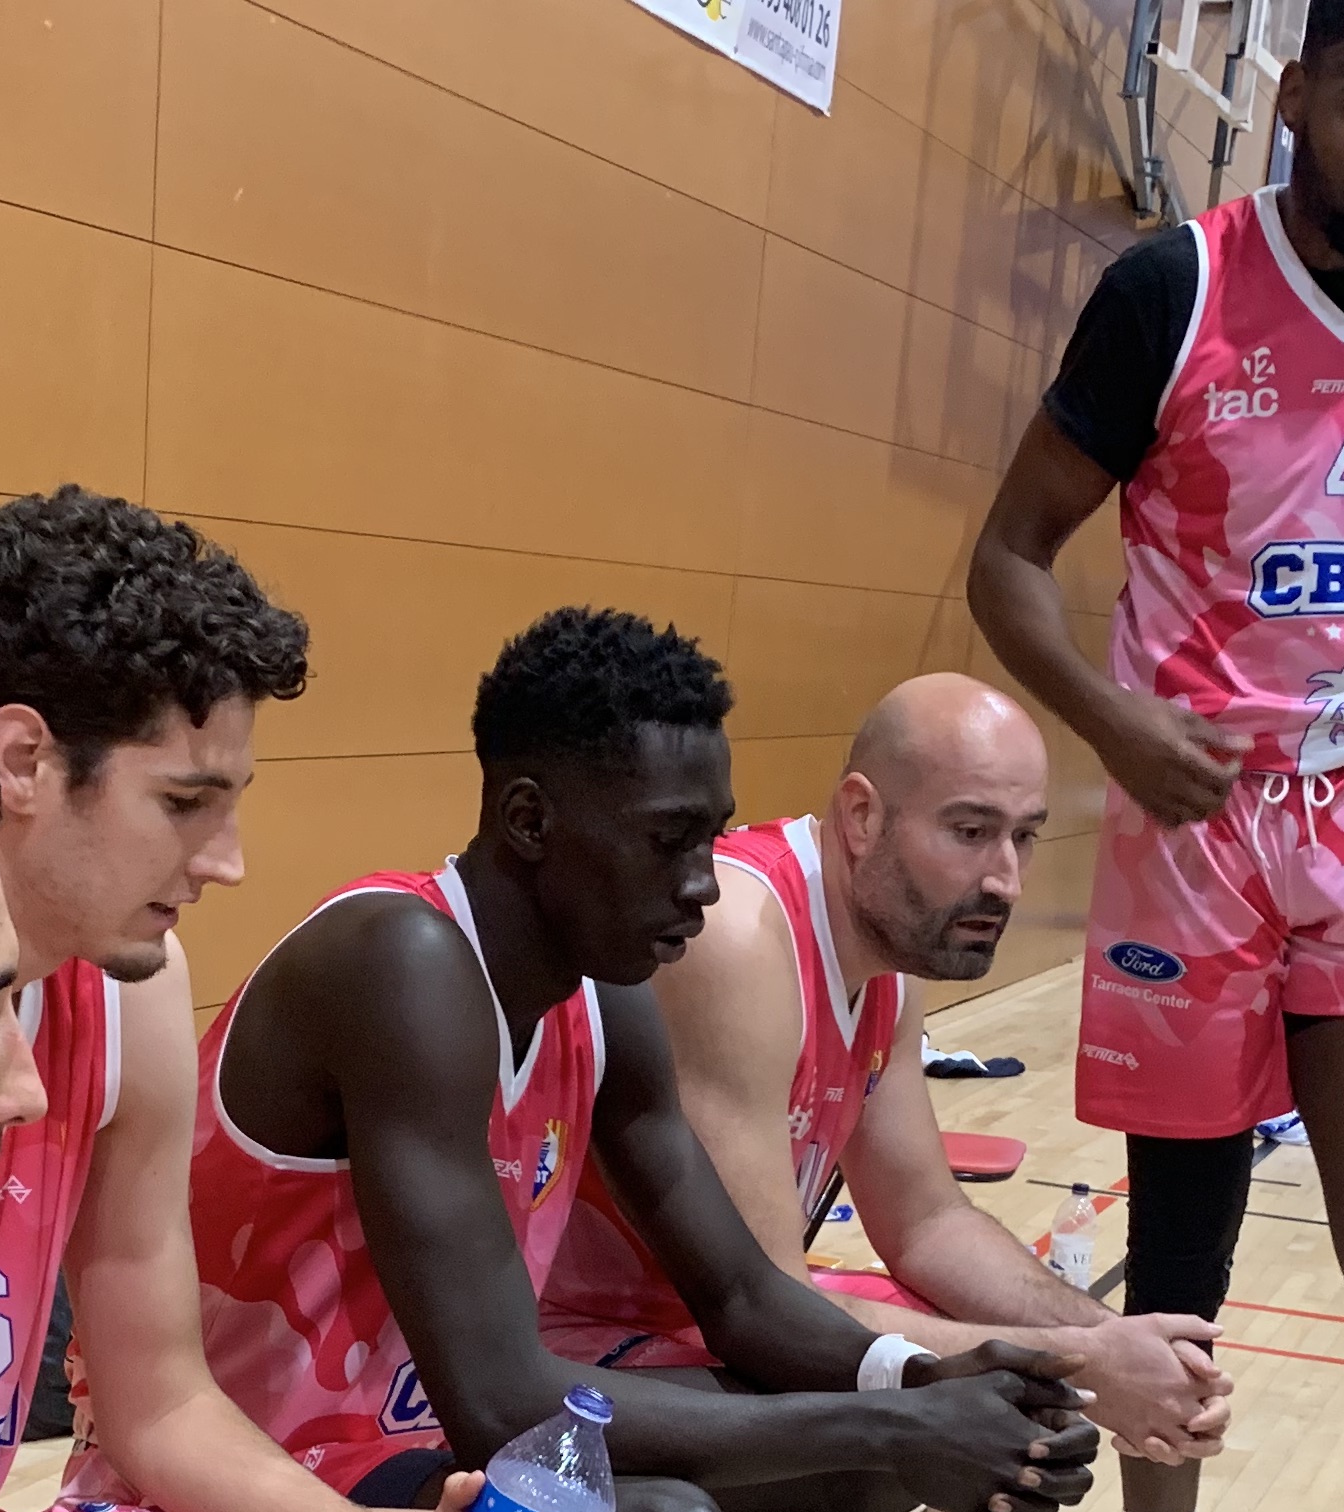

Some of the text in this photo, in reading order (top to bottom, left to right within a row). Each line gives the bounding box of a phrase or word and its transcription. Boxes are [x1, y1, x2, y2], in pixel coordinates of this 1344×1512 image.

[1203, 382, 1280, 422] tac
[1121, 947, 1164, 977] Ford
[1091, 974, 1192, 1009] Tarraco Center
